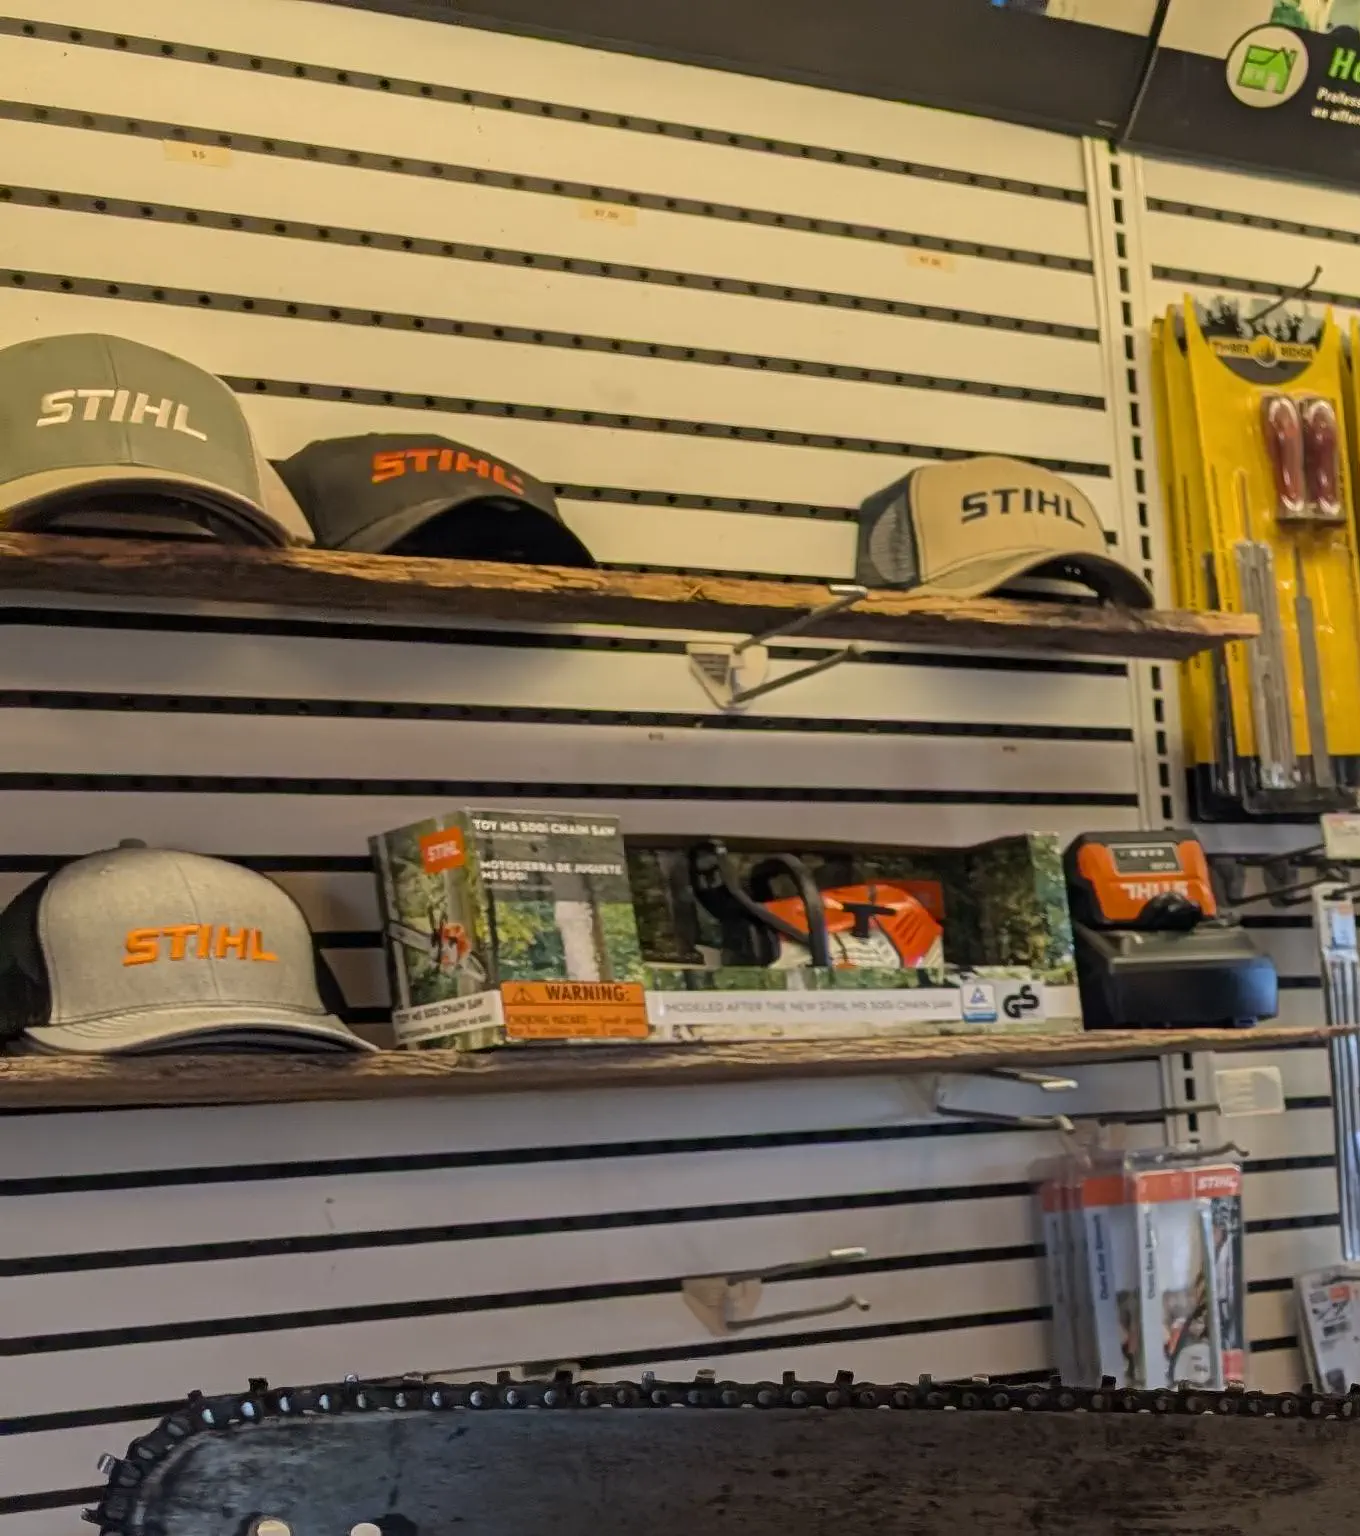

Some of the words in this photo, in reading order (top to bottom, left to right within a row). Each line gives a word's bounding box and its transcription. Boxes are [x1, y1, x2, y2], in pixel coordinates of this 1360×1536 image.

[36, 388, 208, 442] STIHL
[371, 447, 525, 496] STIHL
[960, 487, 1087, 528] STIHL
[472, 819, 498, 831] TOY
[500, 821, 518, 832] MS
[551, 823, 590, 835] CHAIN
[591, 825, 616, 836] SAW
[426, 840, 461, 861] STIHL
[122, 924, 280, 967] STIHL
[545, 984, 630, 1002] WARNING:
